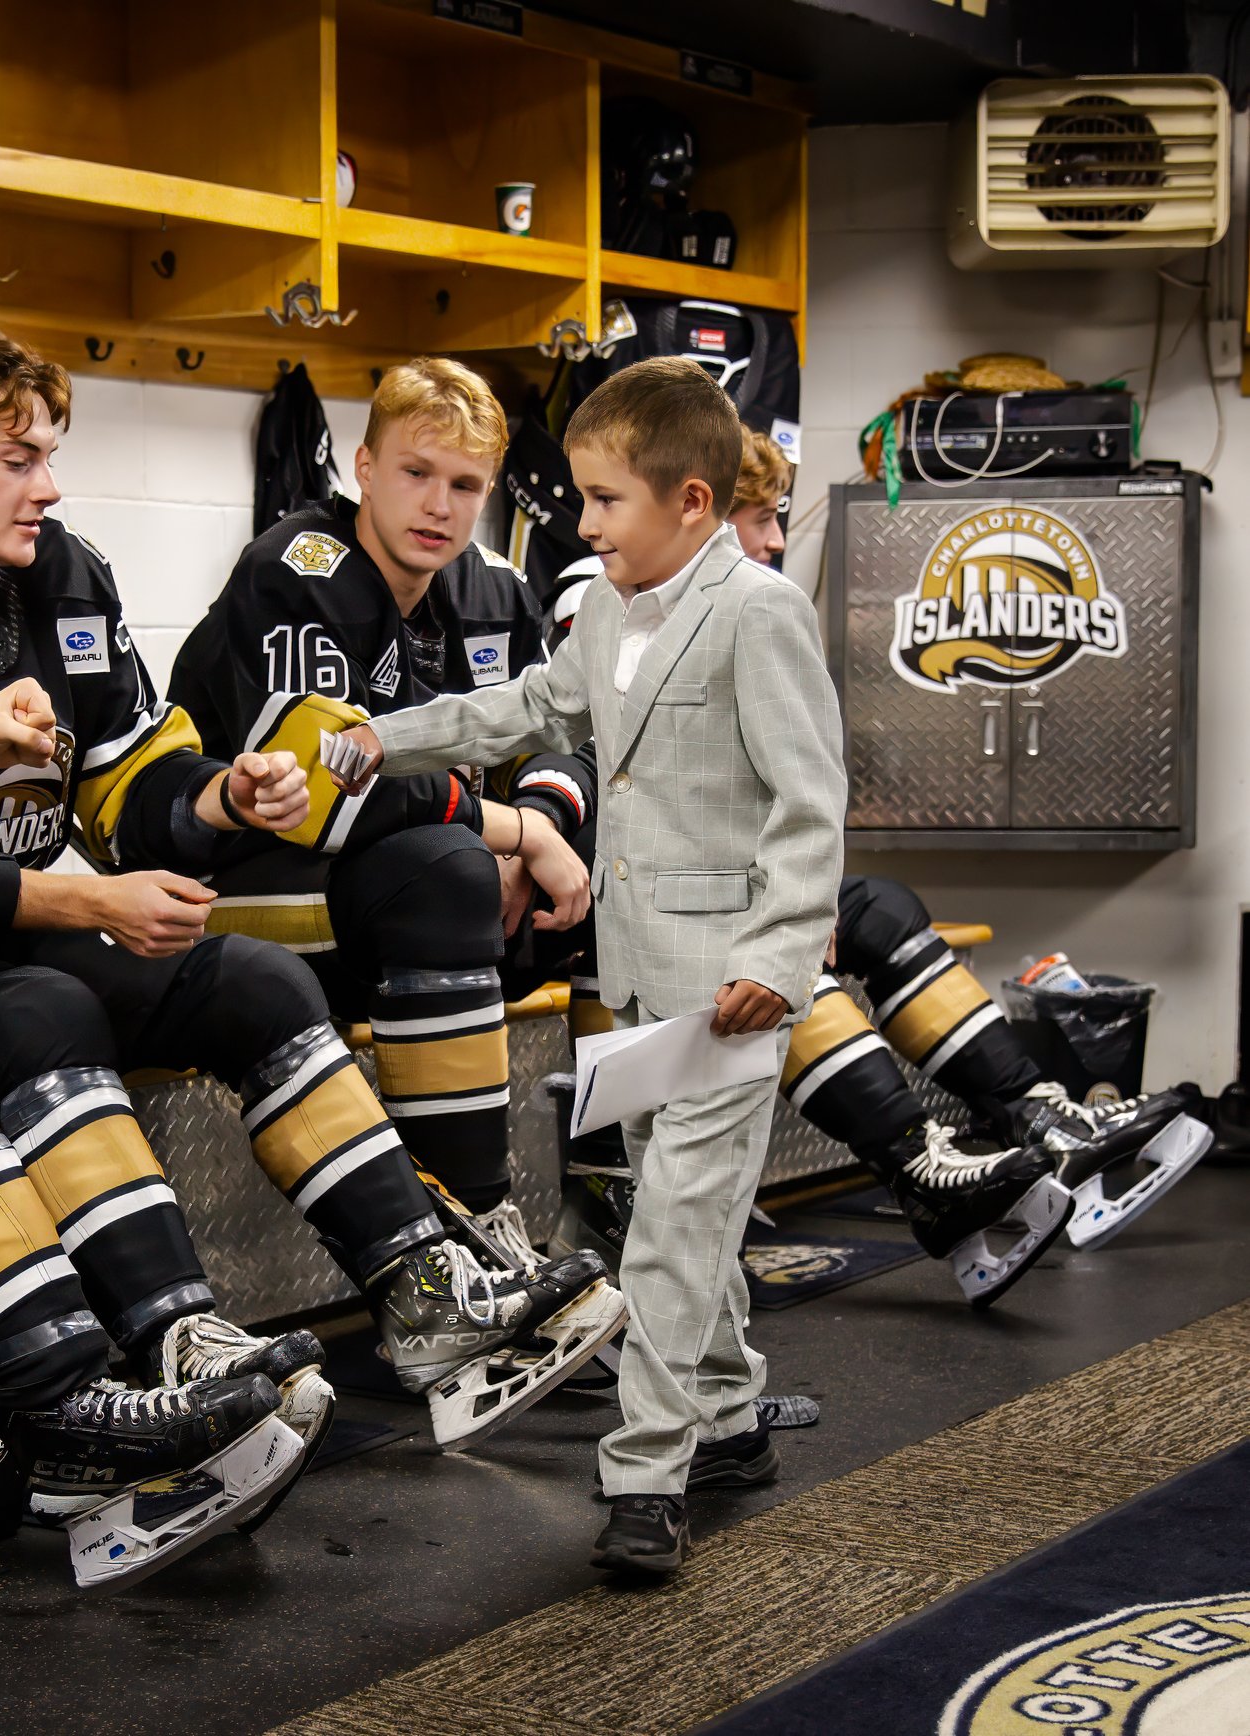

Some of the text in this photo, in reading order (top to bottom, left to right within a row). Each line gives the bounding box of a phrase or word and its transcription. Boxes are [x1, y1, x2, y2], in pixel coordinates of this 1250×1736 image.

[506, 473, 553, 526] CCM
[931, 512, 1090, 582] CHARLOTTETOWN
[900, 592, 1120, 650] ISLANDERS
[263, 622, 350, 702] 16
[33, 1459, 116, 1481] CCM
[78, 1531, 115, 1557] TRUE
